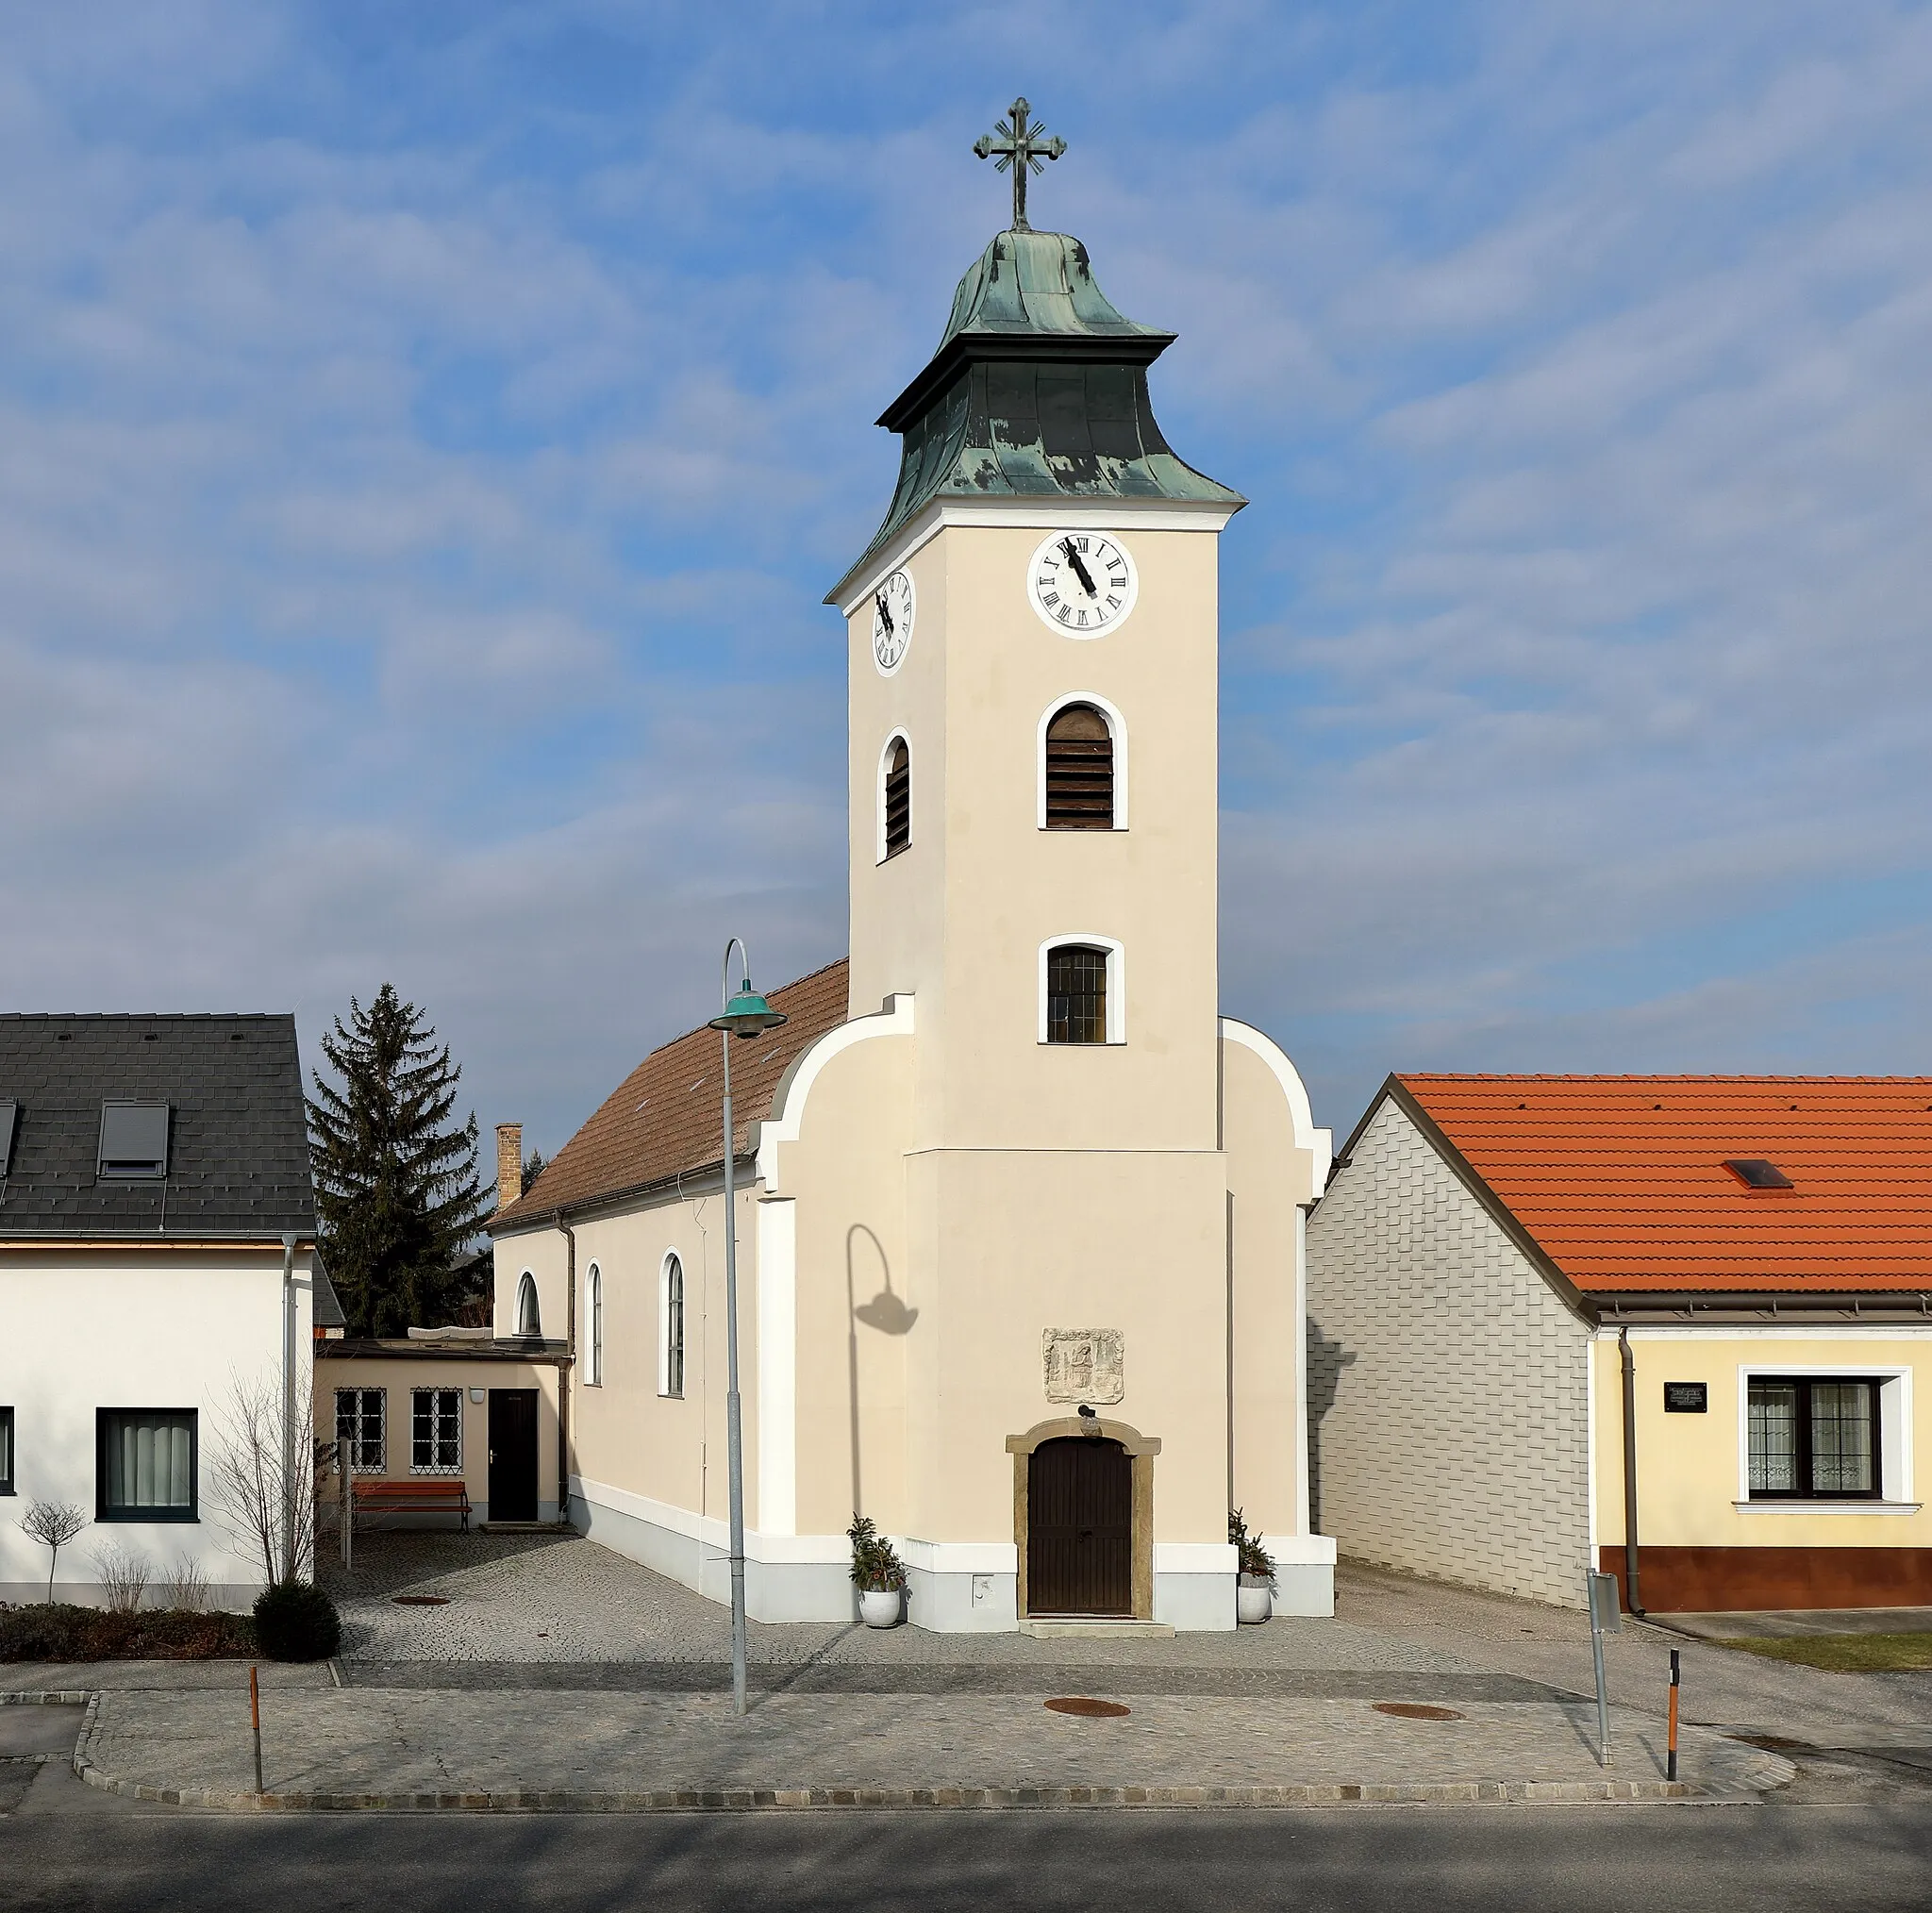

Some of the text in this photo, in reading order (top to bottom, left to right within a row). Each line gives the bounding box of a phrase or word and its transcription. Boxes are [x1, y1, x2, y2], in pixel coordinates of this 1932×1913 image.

[1076, 538, 1090, 553] XII
[1095, 543, 1106, 557] I
[1043, 557, 1059, 570] X
[1106, 557, 1122, 571] II
[1039, 576, 1055, 585] IX
[1110, 577, 1125, 587] III
[1042, 591, 1059, 609] VIII
[1106, 594, 1123, 610] IV
[1057, 604, 1072, 623] VII
[1076, 609, 1089, 625] VI
[1095, 607, 1108, 622] V
